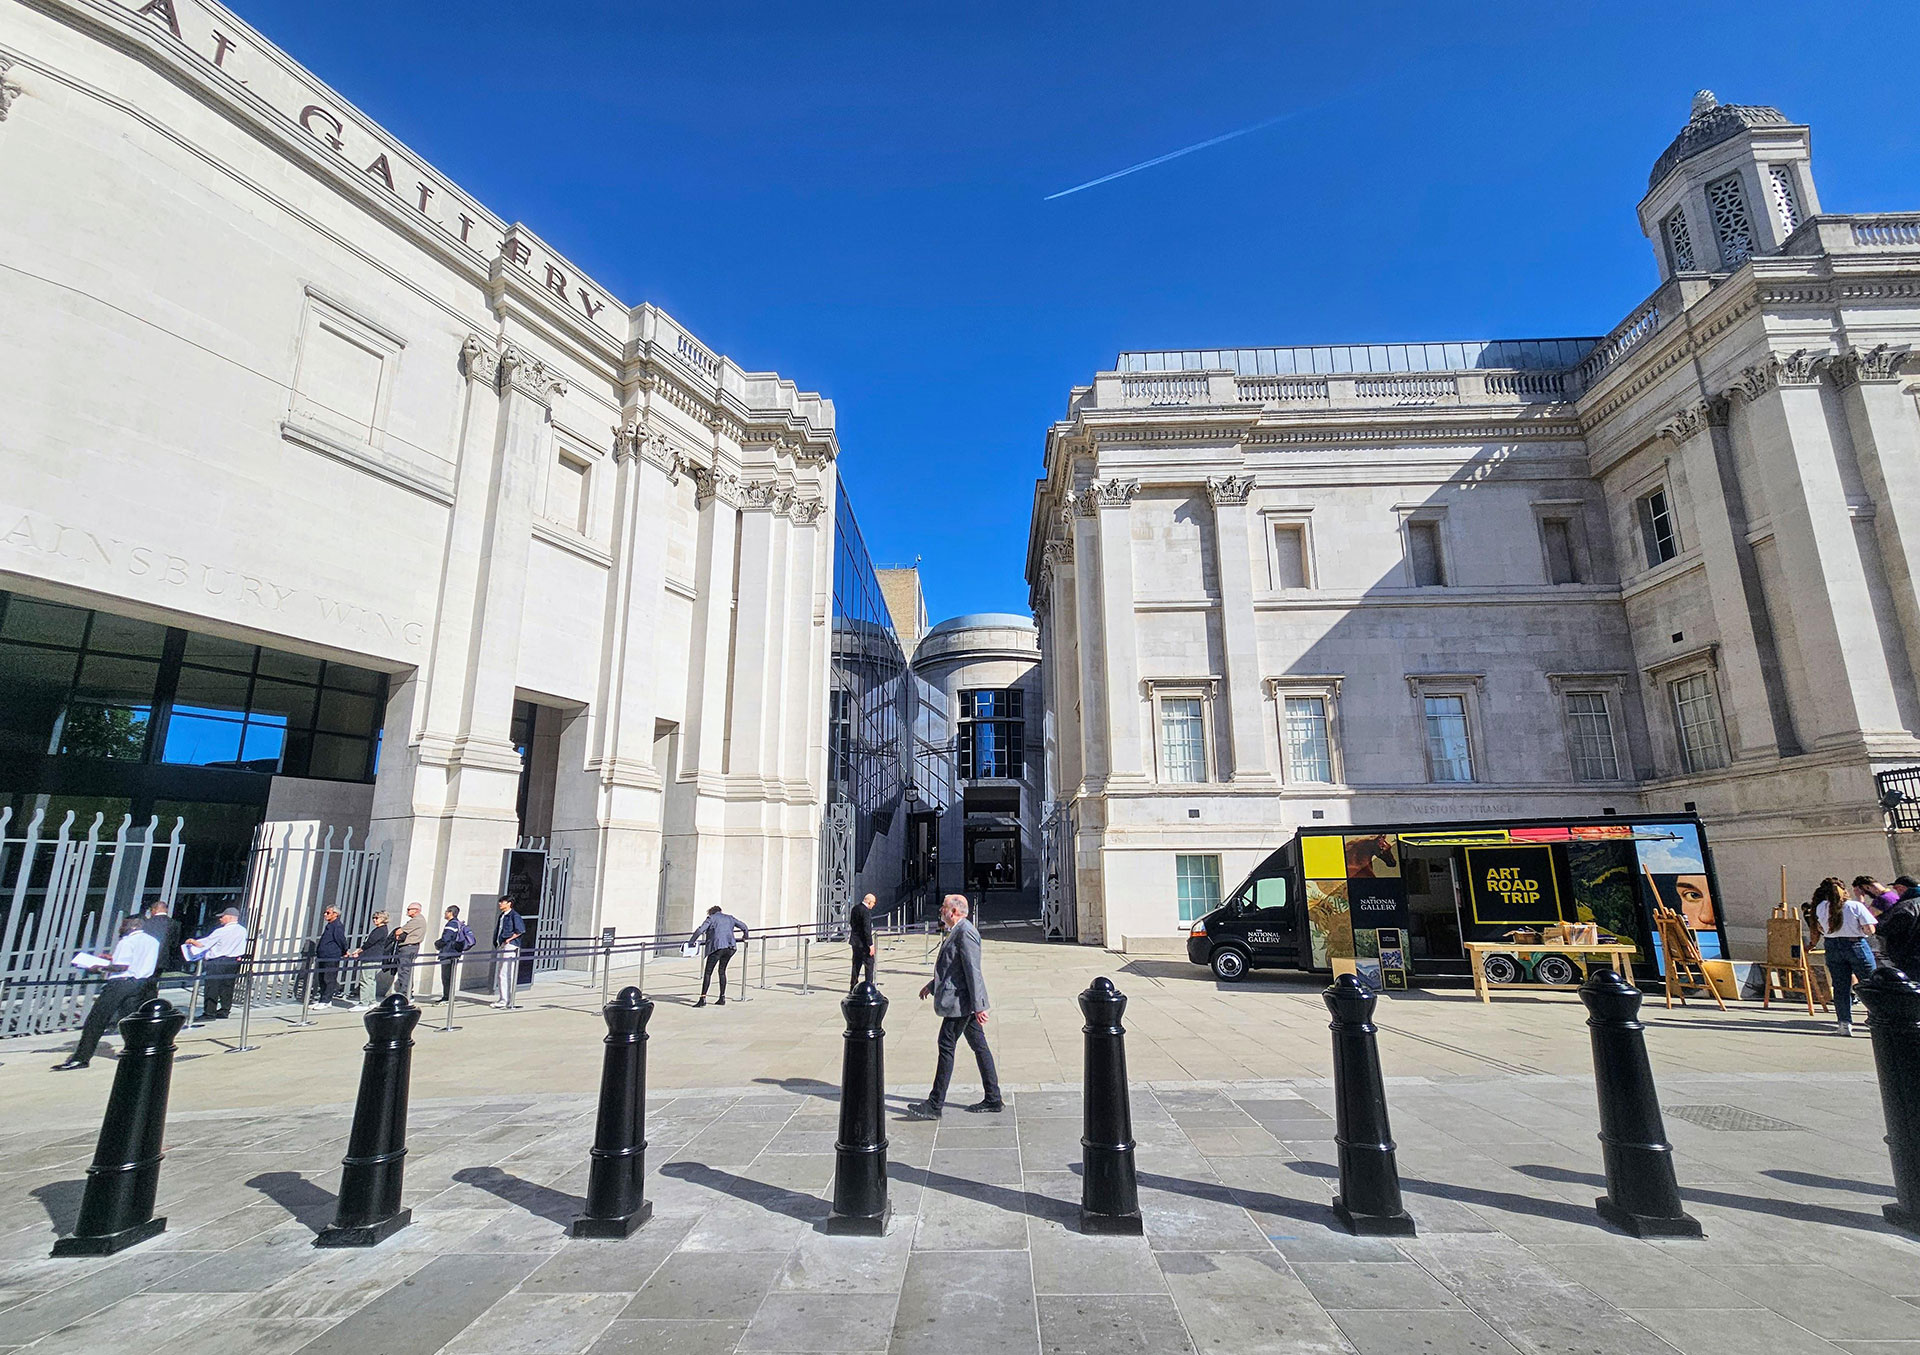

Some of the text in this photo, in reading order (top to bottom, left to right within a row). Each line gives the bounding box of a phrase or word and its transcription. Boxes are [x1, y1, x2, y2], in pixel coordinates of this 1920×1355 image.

[299, 104, 605, 319] GALLERY
[0, 514, 424, 646] AINSBURY WING
[1487, 868, 1520, 879] ART
[1487, 880, 1539, 892] ROAD
[1500, 892, 1541, 904] TRIP
